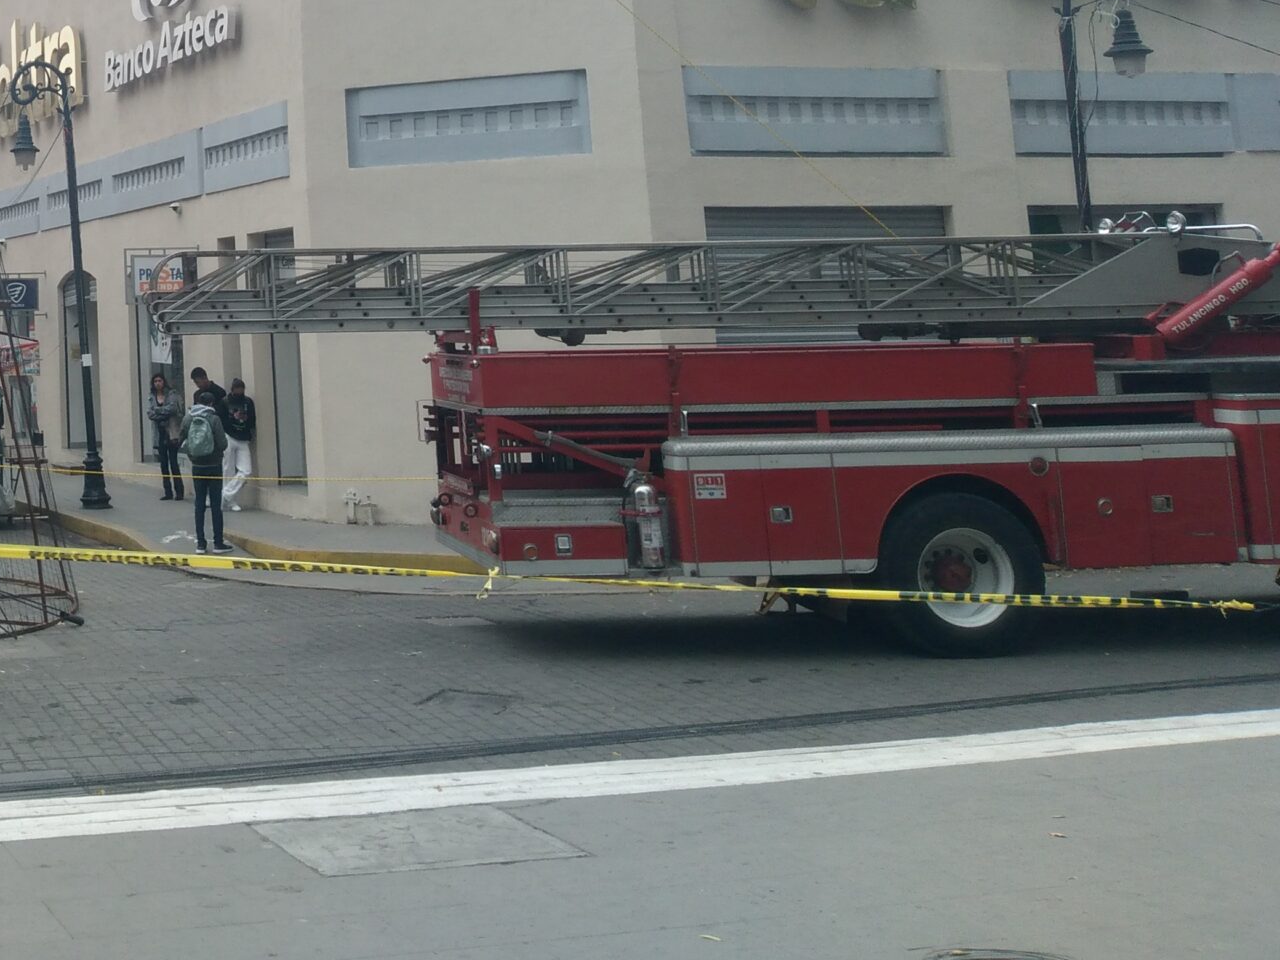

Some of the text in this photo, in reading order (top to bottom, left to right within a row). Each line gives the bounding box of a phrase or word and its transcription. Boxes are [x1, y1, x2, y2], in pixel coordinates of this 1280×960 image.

[105, 5, 229, 90] Banco Azteca
[697, 477, 721, 485] 911
